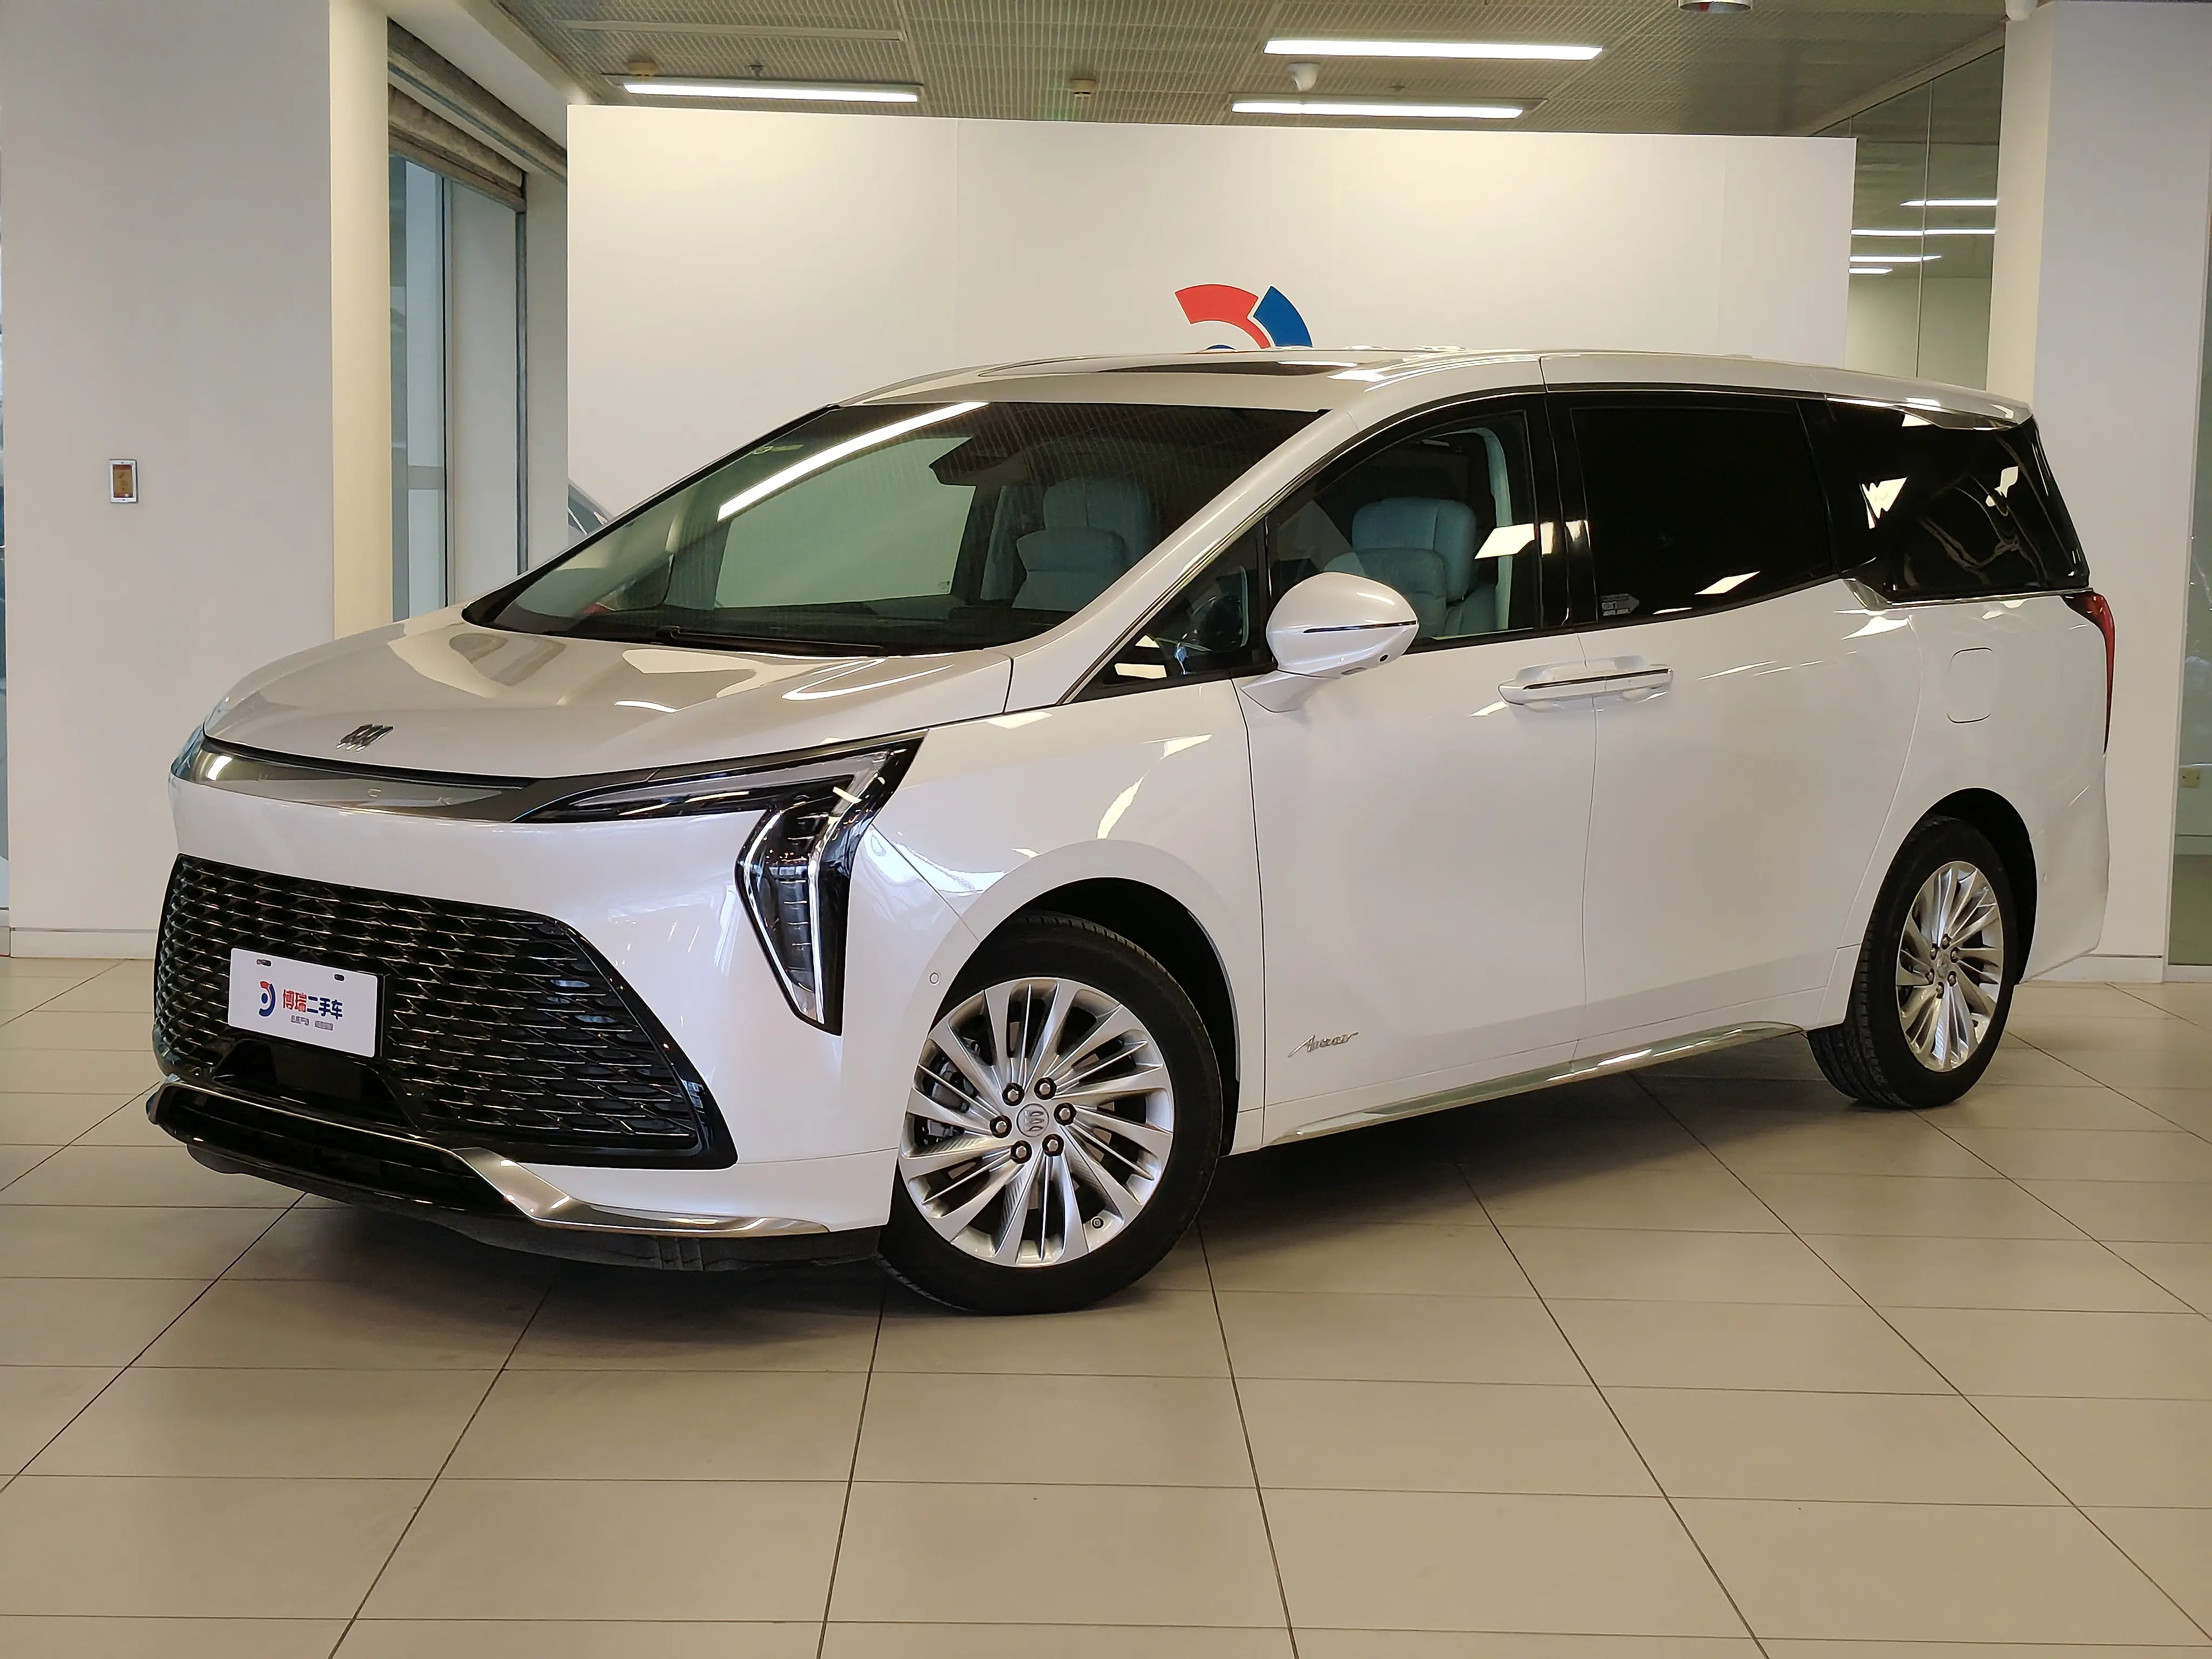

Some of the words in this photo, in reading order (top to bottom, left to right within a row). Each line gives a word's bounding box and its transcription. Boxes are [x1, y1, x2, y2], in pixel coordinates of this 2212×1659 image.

[283, 989, 343, 1020] 博瑞二手车
